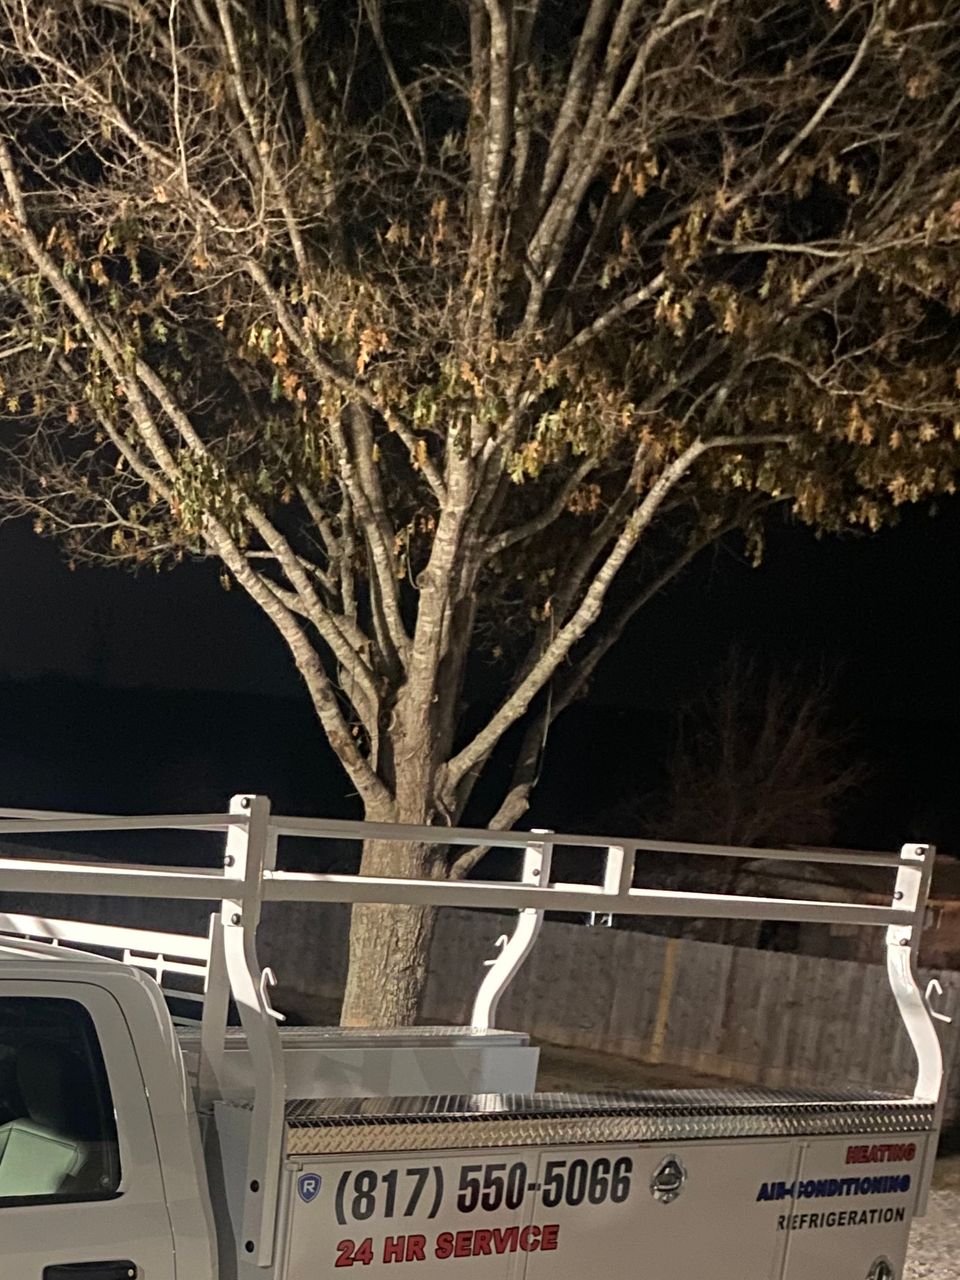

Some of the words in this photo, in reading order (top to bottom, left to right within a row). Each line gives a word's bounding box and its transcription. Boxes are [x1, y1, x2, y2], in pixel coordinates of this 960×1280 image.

[845, 1143, 916, 1165] HEATING
[335, 1166, 444, 1225] (817)
[457, 1156, 634, 1214] 550-5066
[755, 1174, 911, 1202] AIR-CONDITIONING
[776, 1207, 906, 1231] REFRIGERATION
[334, 1238, 374, 1267] 24
[383, 1234, 427, 1264] HR
[434, 1224, 559, 1260] SERVICE
